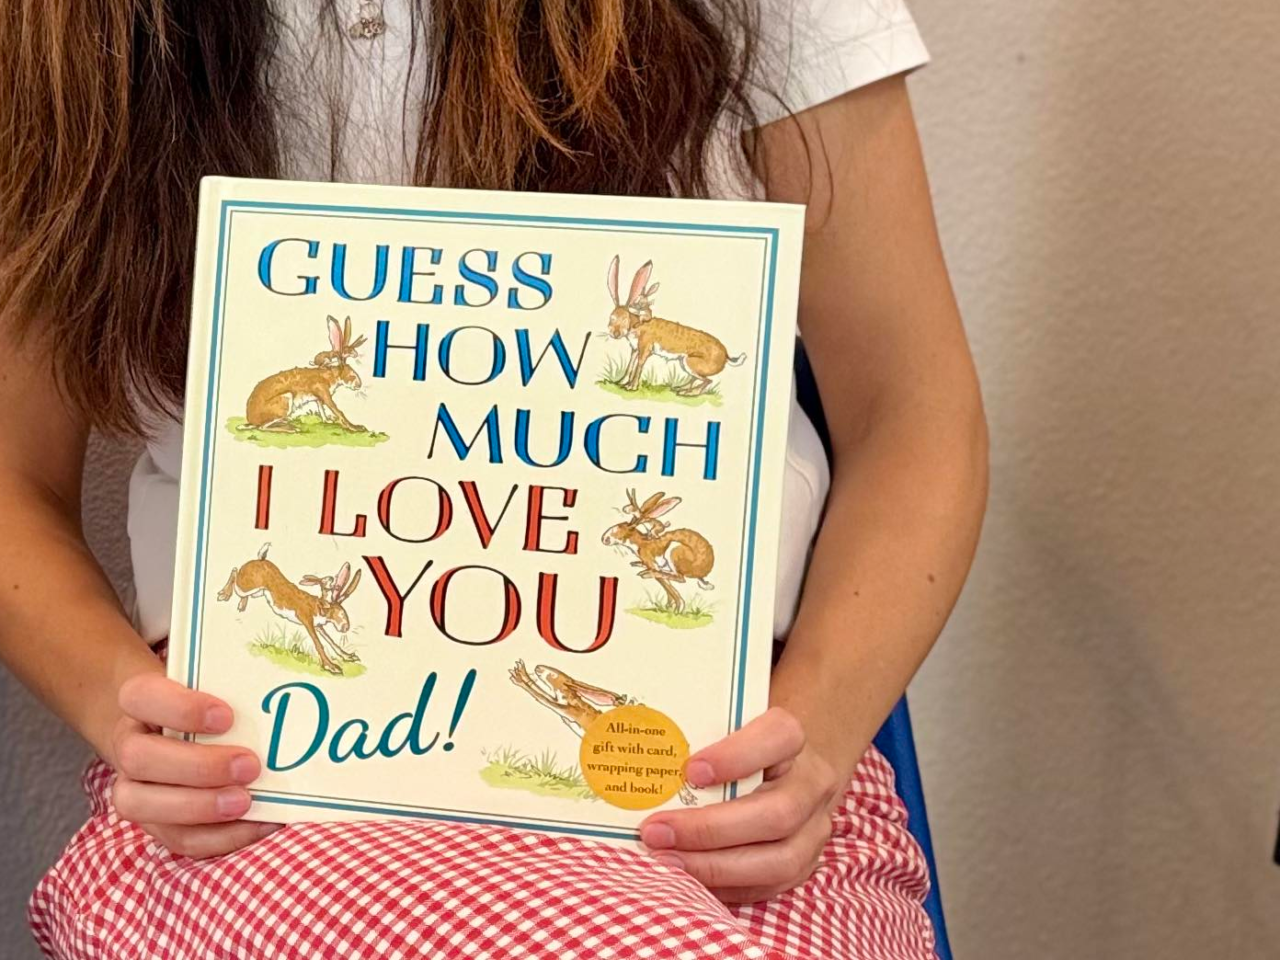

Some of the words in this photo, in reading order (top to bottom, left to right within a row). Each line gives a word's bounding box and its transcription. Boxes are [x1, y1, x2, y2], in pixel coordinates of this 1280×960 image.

[256, 237, 554, 311] GUESS
[371, 319, 592, 390] HOW
[427, 402, 721, 481] MUCH
[255, 464, 273, 530] I
[318, 469, 579, 555] LOVE
[360, 554, 619, 655] YOU
[260, 667, 478, 773] Dad!
[592, 740, 615, 755] gift
[617, 742, 644, 755] with
[646, 744, 677, 759] card,
[605, 722, 666, 737] All-in-one
[586, 762, 643, 777] wrapping
[645, 766, 683, 779] paper,
[604, 781, 627, 793] and
[630, 781, 663, 795] book!
